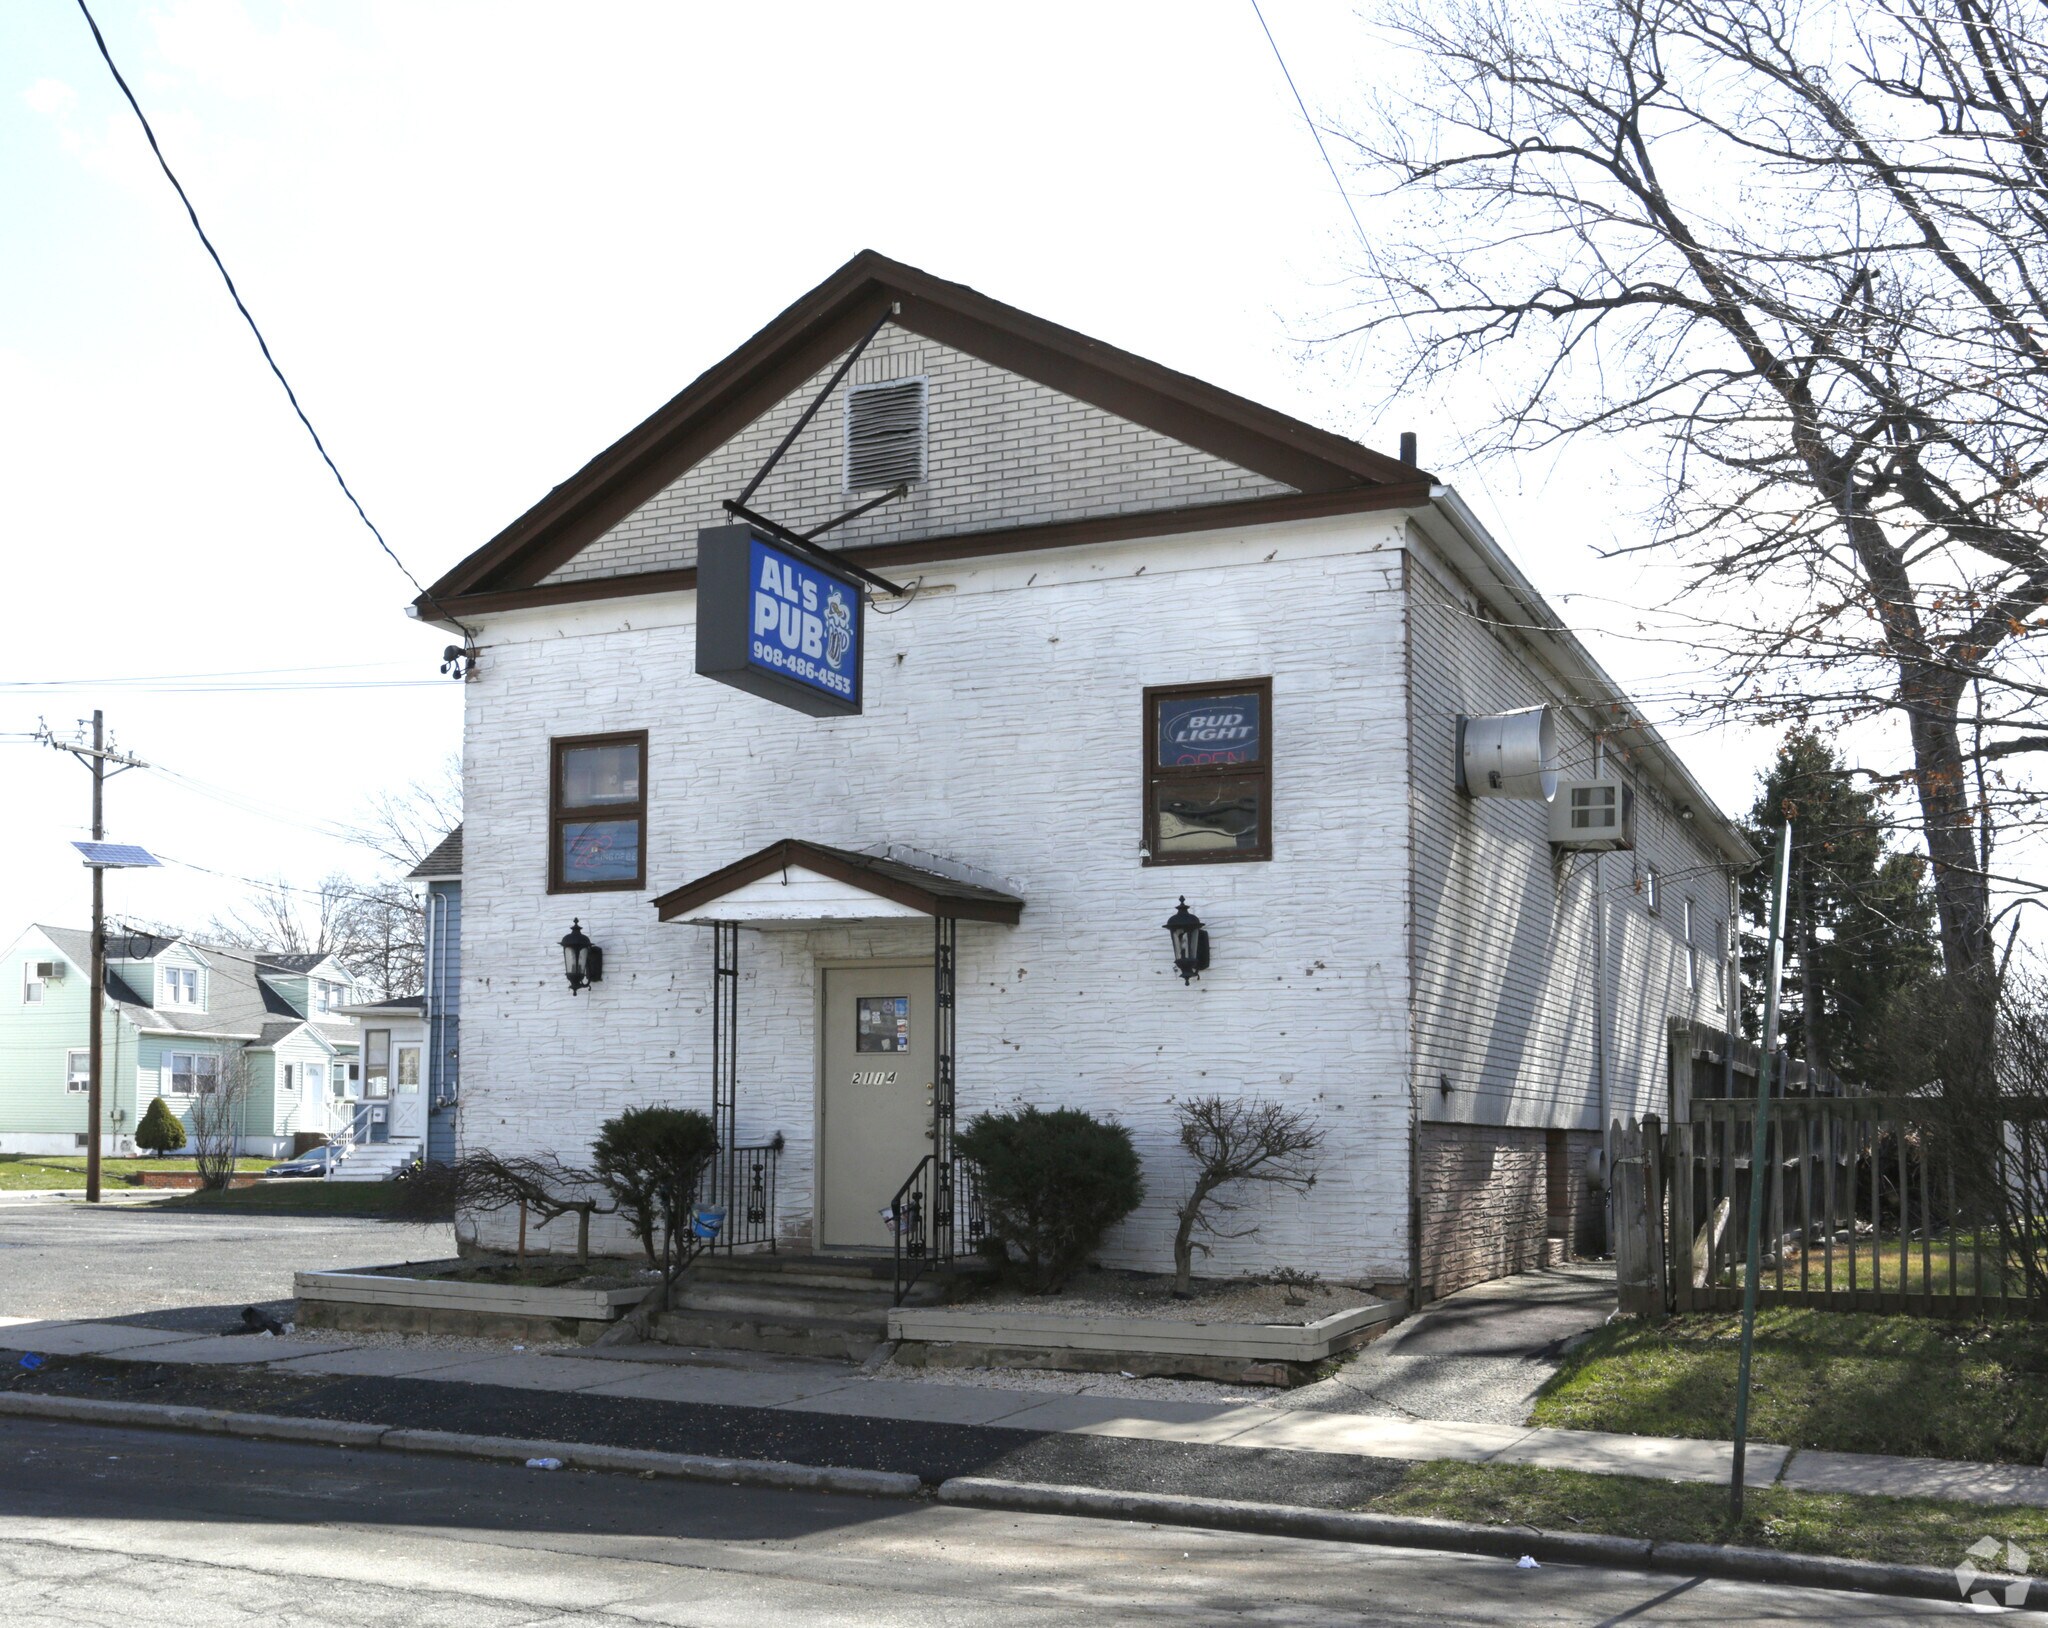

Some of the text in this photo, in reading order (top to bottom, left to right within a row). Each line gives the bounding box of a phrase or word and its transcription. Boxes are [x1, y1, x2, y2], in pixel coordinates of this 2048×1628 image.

[760, 555, 818, 612] AL'S
[754, 590, 824, 660] PUB
[753, 641, 851, 695] 908-486-4553
[1175, 726, 1254, 742] LIGHT
[1188, 713, 1244, 728] BUD
[852, 1072, 897, 1085] 2114
